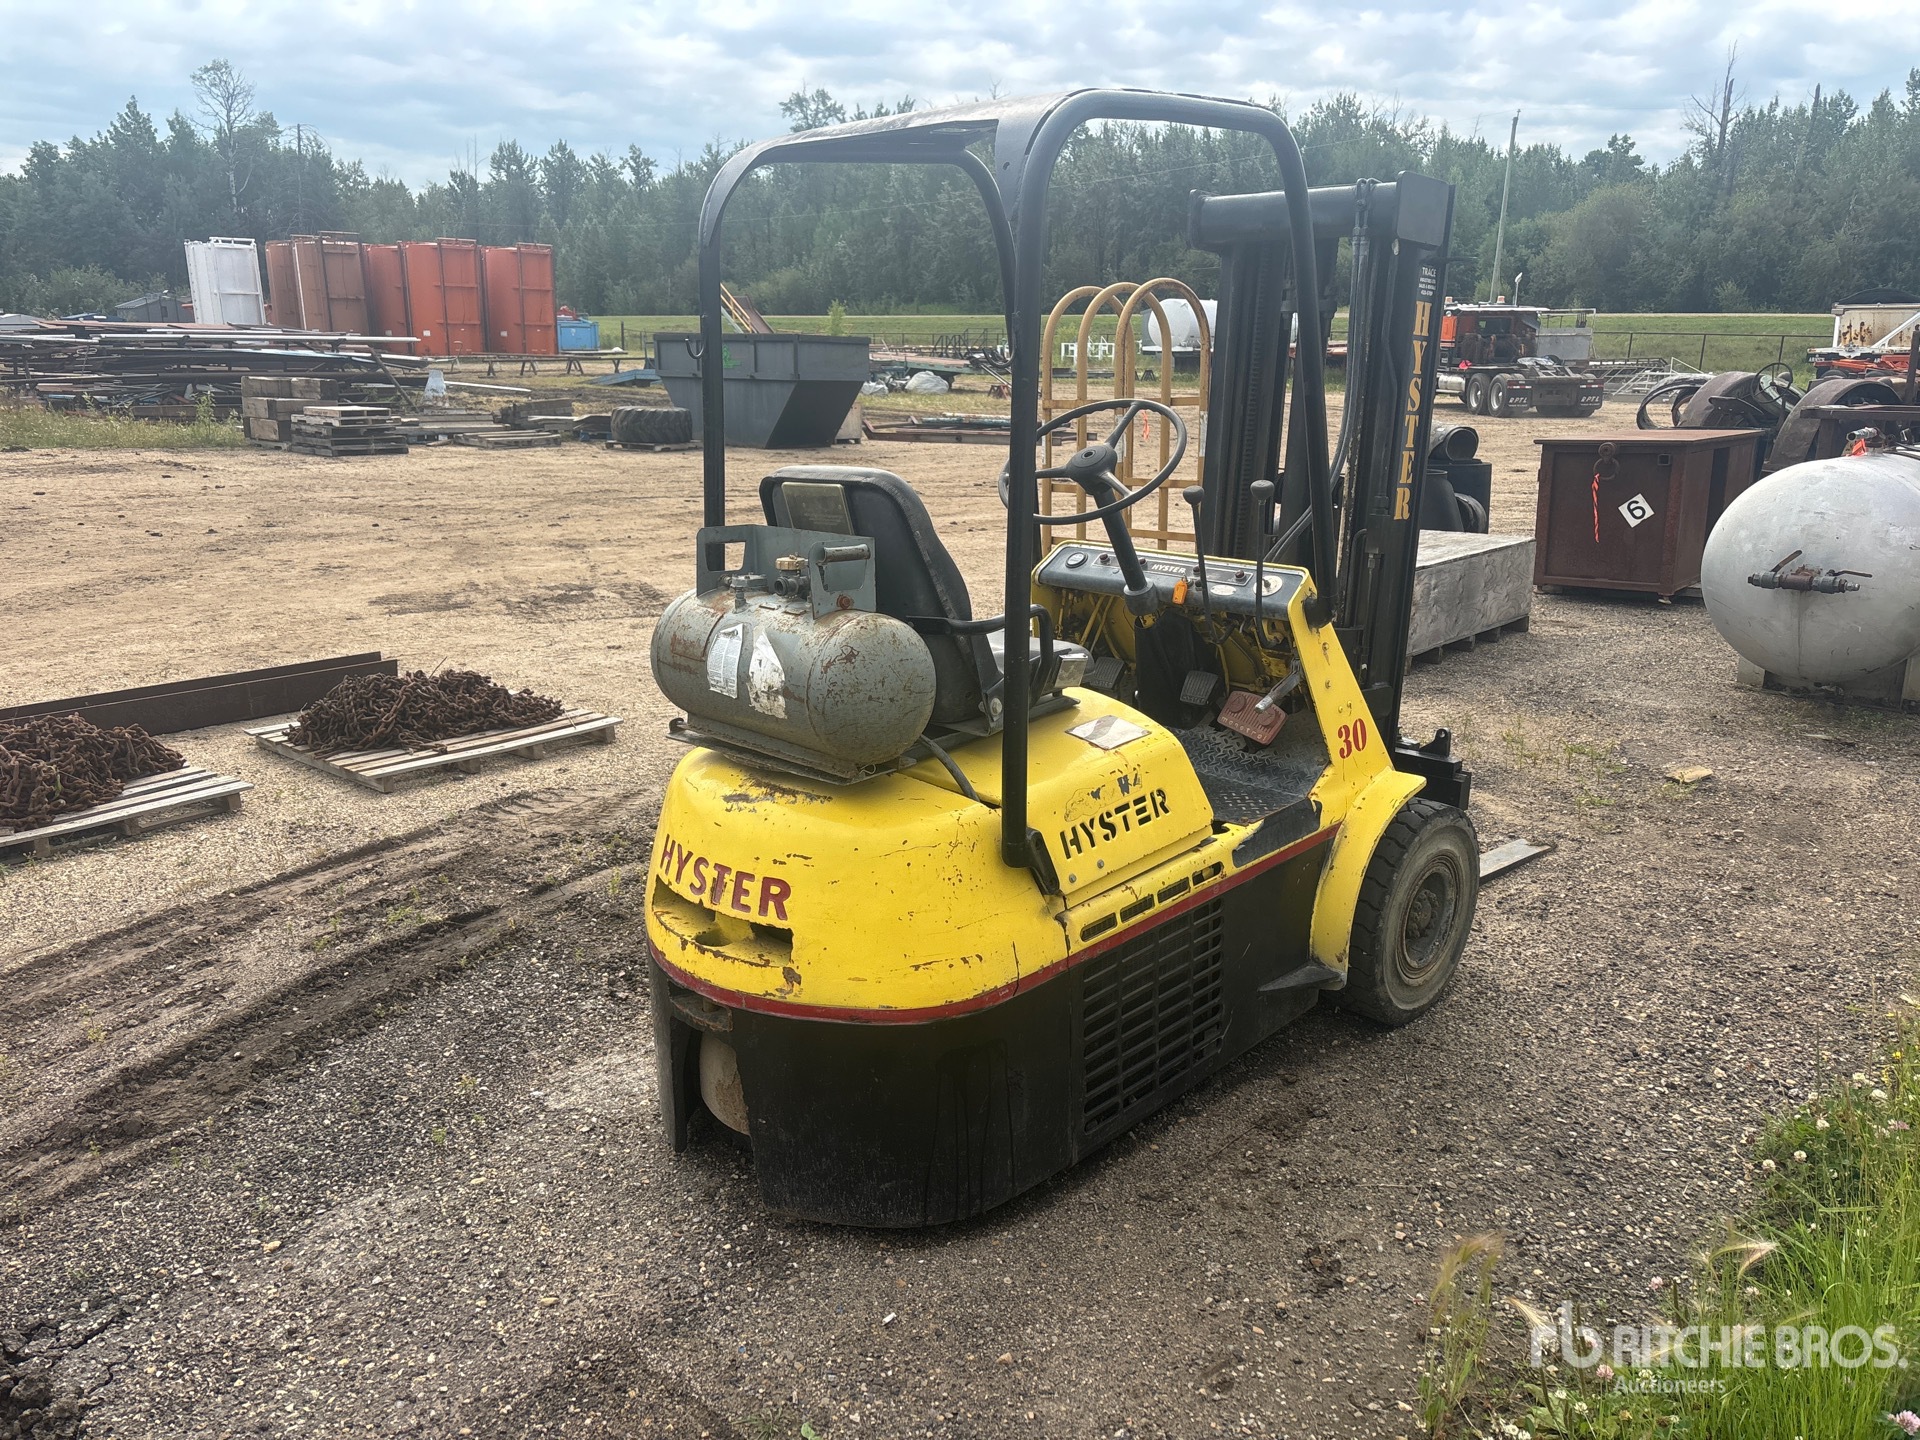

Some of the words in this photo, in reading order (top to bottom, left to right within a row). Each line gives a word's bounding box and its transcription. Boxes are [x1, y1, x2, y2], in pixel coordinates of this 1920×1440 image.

[1422, 266, 1436, 277] TRACE
[1394, 301, 1432, 520] HYSTER
[1627, 500, 1646, 520] 6
[1151, 564, 1186, 574] HYSTER
[1221, 716, 1267, 741] monotrol
[1337, 718, 1367, 759] 30
[1059, 789, 1170, 860] HYSTER
[660, 834, 791, 921] HYSTER
